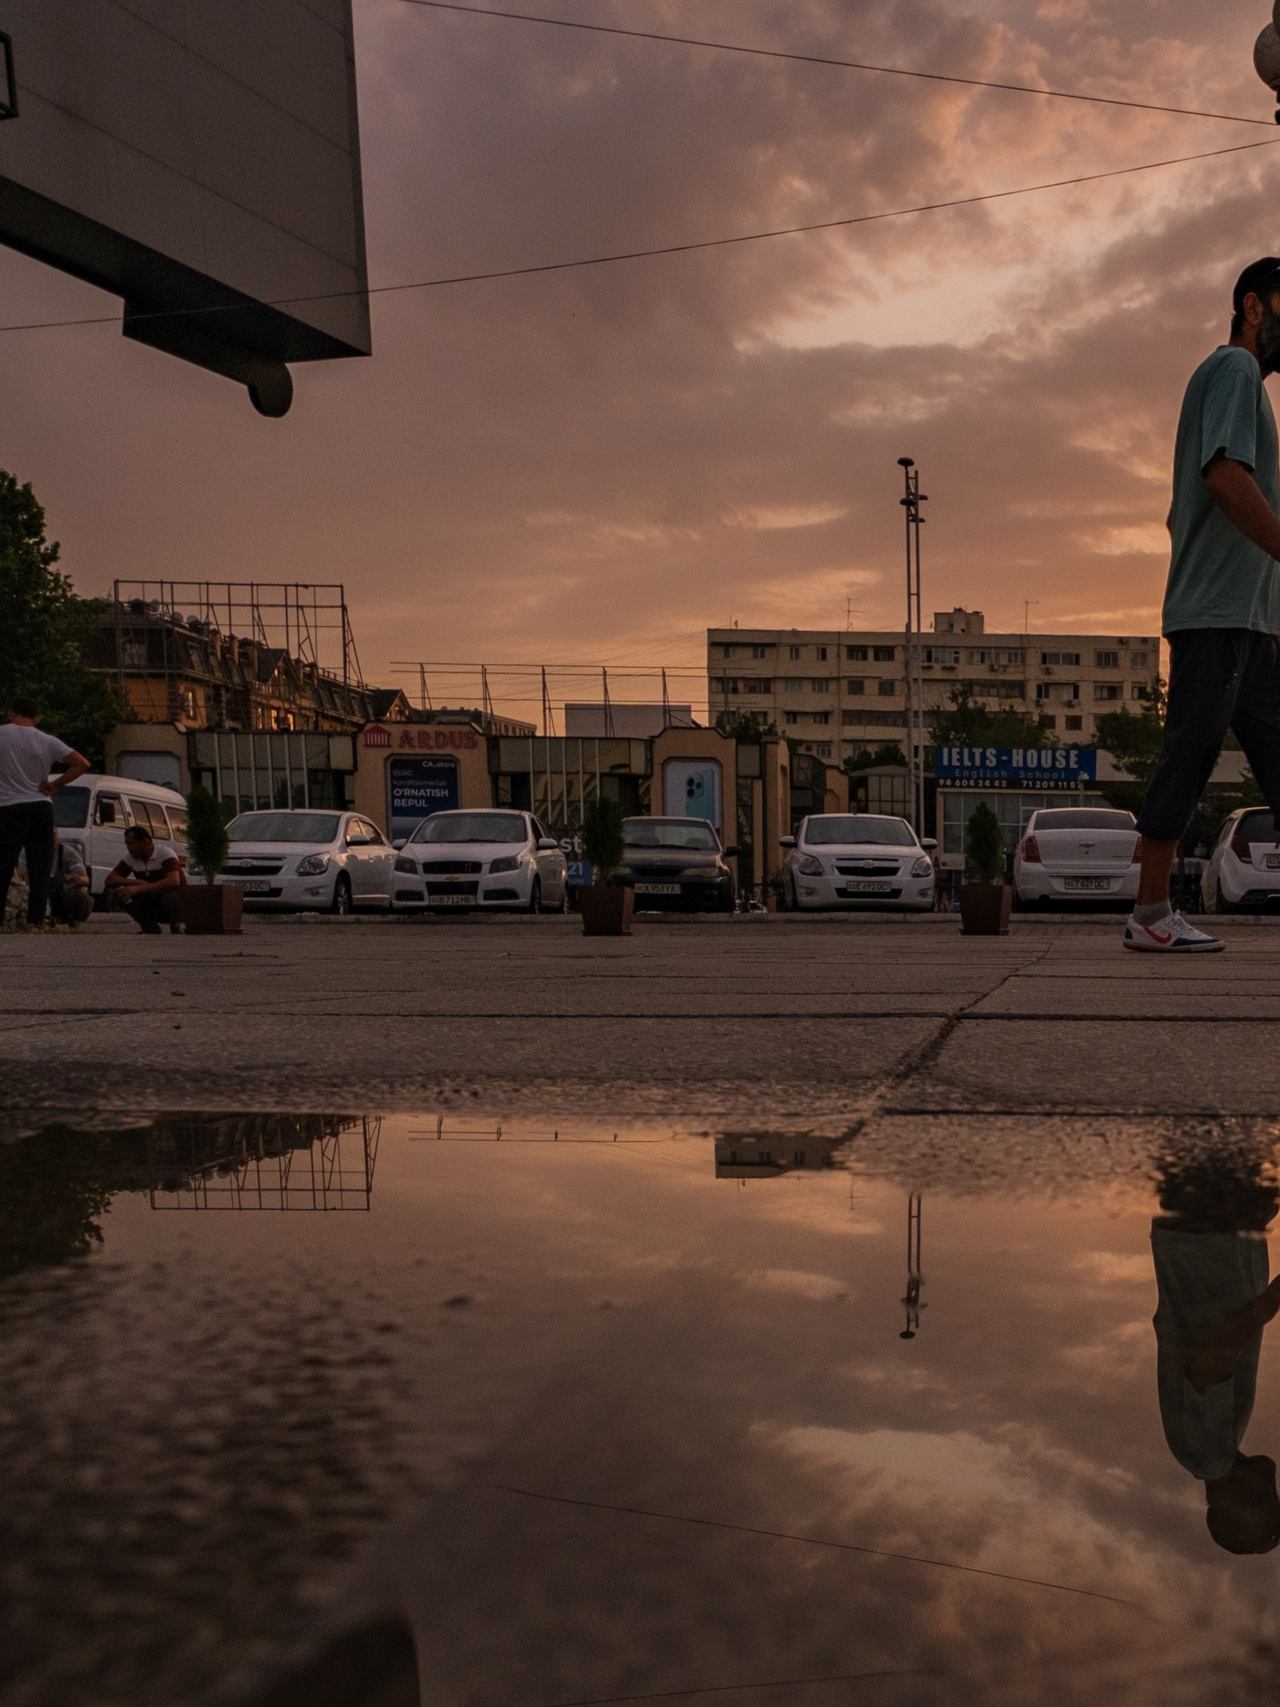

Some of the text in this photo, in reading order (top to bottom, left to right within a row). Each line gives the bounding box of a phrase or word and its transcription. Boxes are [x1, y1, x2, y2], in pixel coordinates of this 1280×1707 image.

[398, 730, 479, 749] ARDUS
[955, 769, 1066, 779] English School
[393, 788, 449, 797] O'RNATISH
[394, 799, 428, 807] BEPUL
